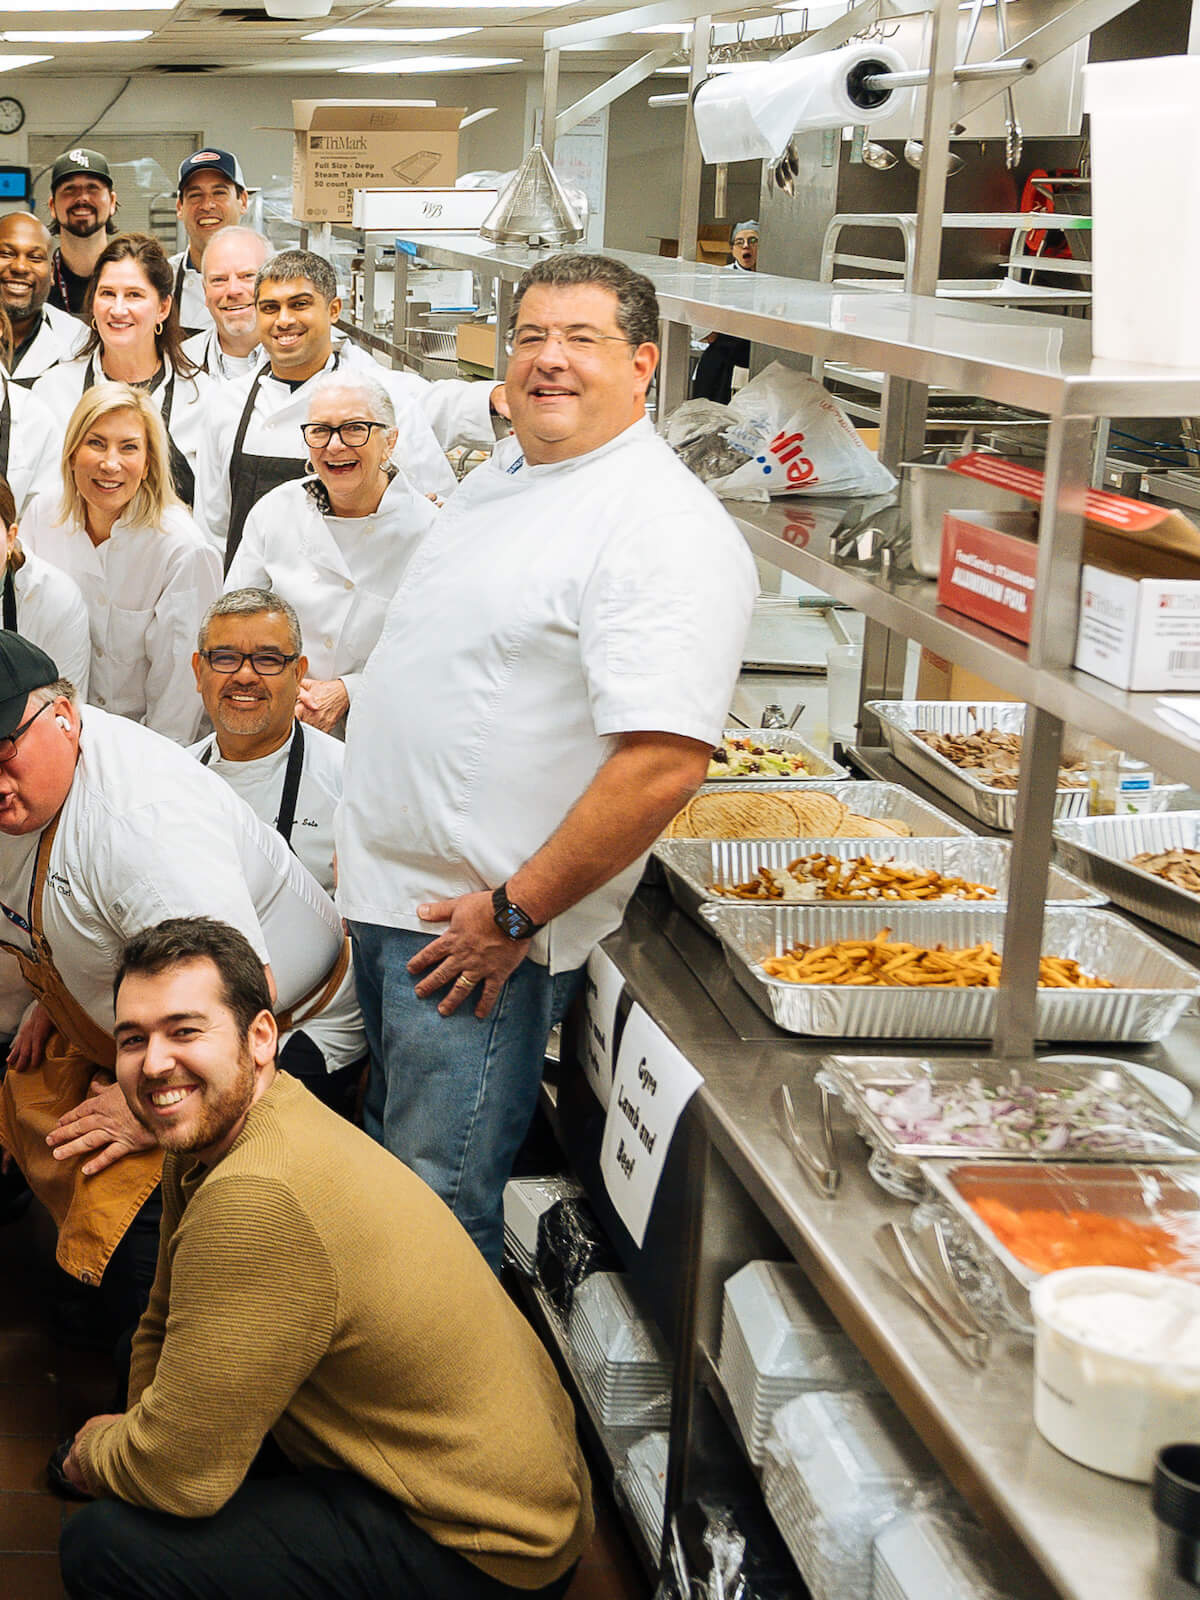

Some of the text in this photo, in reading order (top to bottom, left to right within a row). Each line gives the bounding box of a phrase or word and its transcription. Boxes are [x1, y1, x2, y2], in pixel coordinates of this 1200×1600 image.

[321, 135, 368, 150] TriMark
[314, 161, 330, 169] Full
[332, 161, 348, 169] Size
[354, 162, 375, 170] Deep
[616, 1084, 657, 1156] Lamb and
[616, 1137, 636, 1181] Beef
